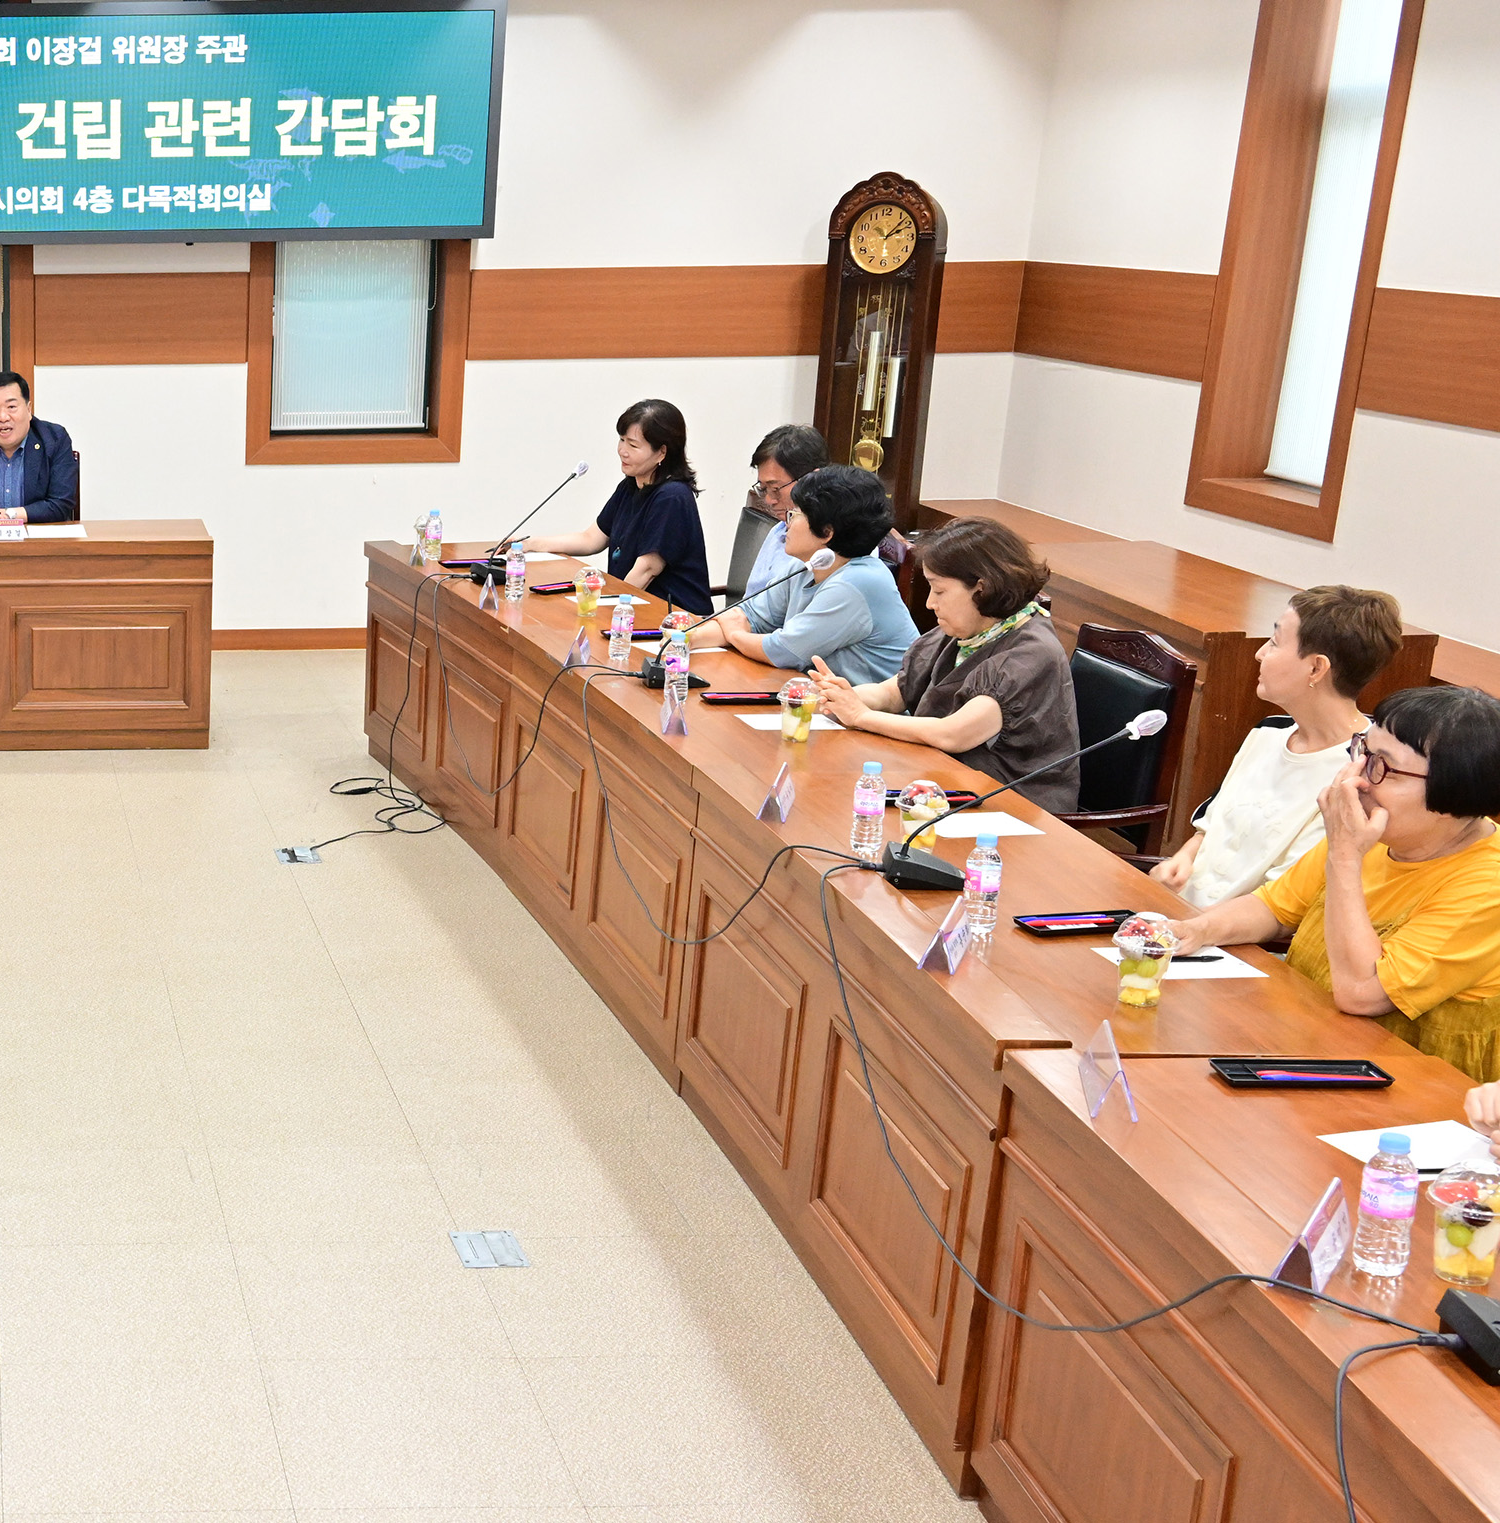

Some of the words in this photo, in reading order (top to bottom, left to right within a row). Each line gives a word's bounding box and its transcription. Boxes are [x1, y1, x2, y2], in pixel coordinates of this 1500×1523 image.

[26, 36, 102, 65] 이장걸
[112, 35, 188, 64] 위원장
[196, 34, 248, 63] 주관
[16, 99, 122, 160] 건립
[145, 98, 252, 158] 관련
[276, 95, 437, 157] 간담회
[73, 186, 115, 213] 4층
[123, 183, 272, 213] 다목적회의실
[881, 207, 893, 217] 12
[899, 212, 903, 220] 1
[870, 213, 878, 221] 11
[861, 223, 870, 231] 10
[904, 220, 912, 229] 2
[857, 235, 865, 243] 9
[906, 232, 915, 241] 3
[859, 246, 867, 255] 8
[901, 245, 909, 253] 4
[867, 255, 876, 264] 7
[880, 259, 887, 267] 6
[892, 255, 901, 264] 5
